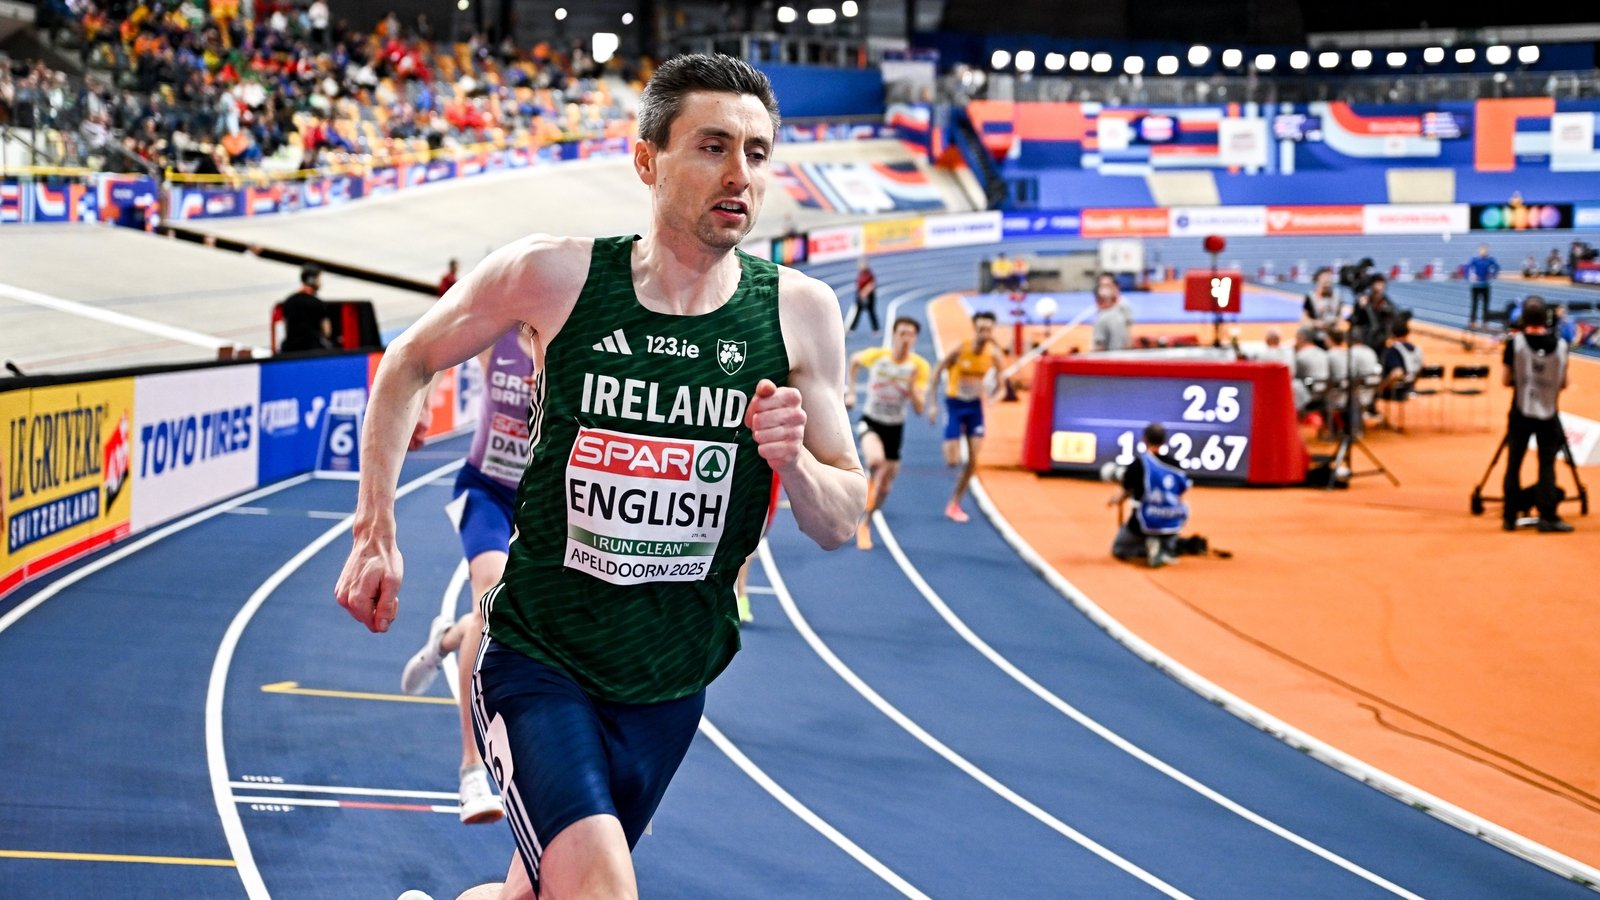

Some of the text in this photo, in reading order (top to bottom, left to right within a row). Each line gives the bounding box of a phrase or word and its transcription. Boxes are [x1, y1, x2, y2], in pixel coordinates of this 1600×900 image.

[646, 335, 699, 358] 123.ie
[581, 373, 747, 428] IRELAND
[1183, 384, 1240, 423] 2.5
[141, 415, 196, 478] TOYO
[201, 405, 252, 460] TIRES
[329, 422, 354, 456] 6
[575, 436, 690, 475] SPAR
[9, 418, 26, 501] LE
[11, 490, 97, 549] SWITZERLAND
[570, 478, 723, 528] ENGLISH
[571, 548, 706, 578] APELDOORN 2025
[593, 535, 596, 546] I
[600, 538, 633, 553] RUN
